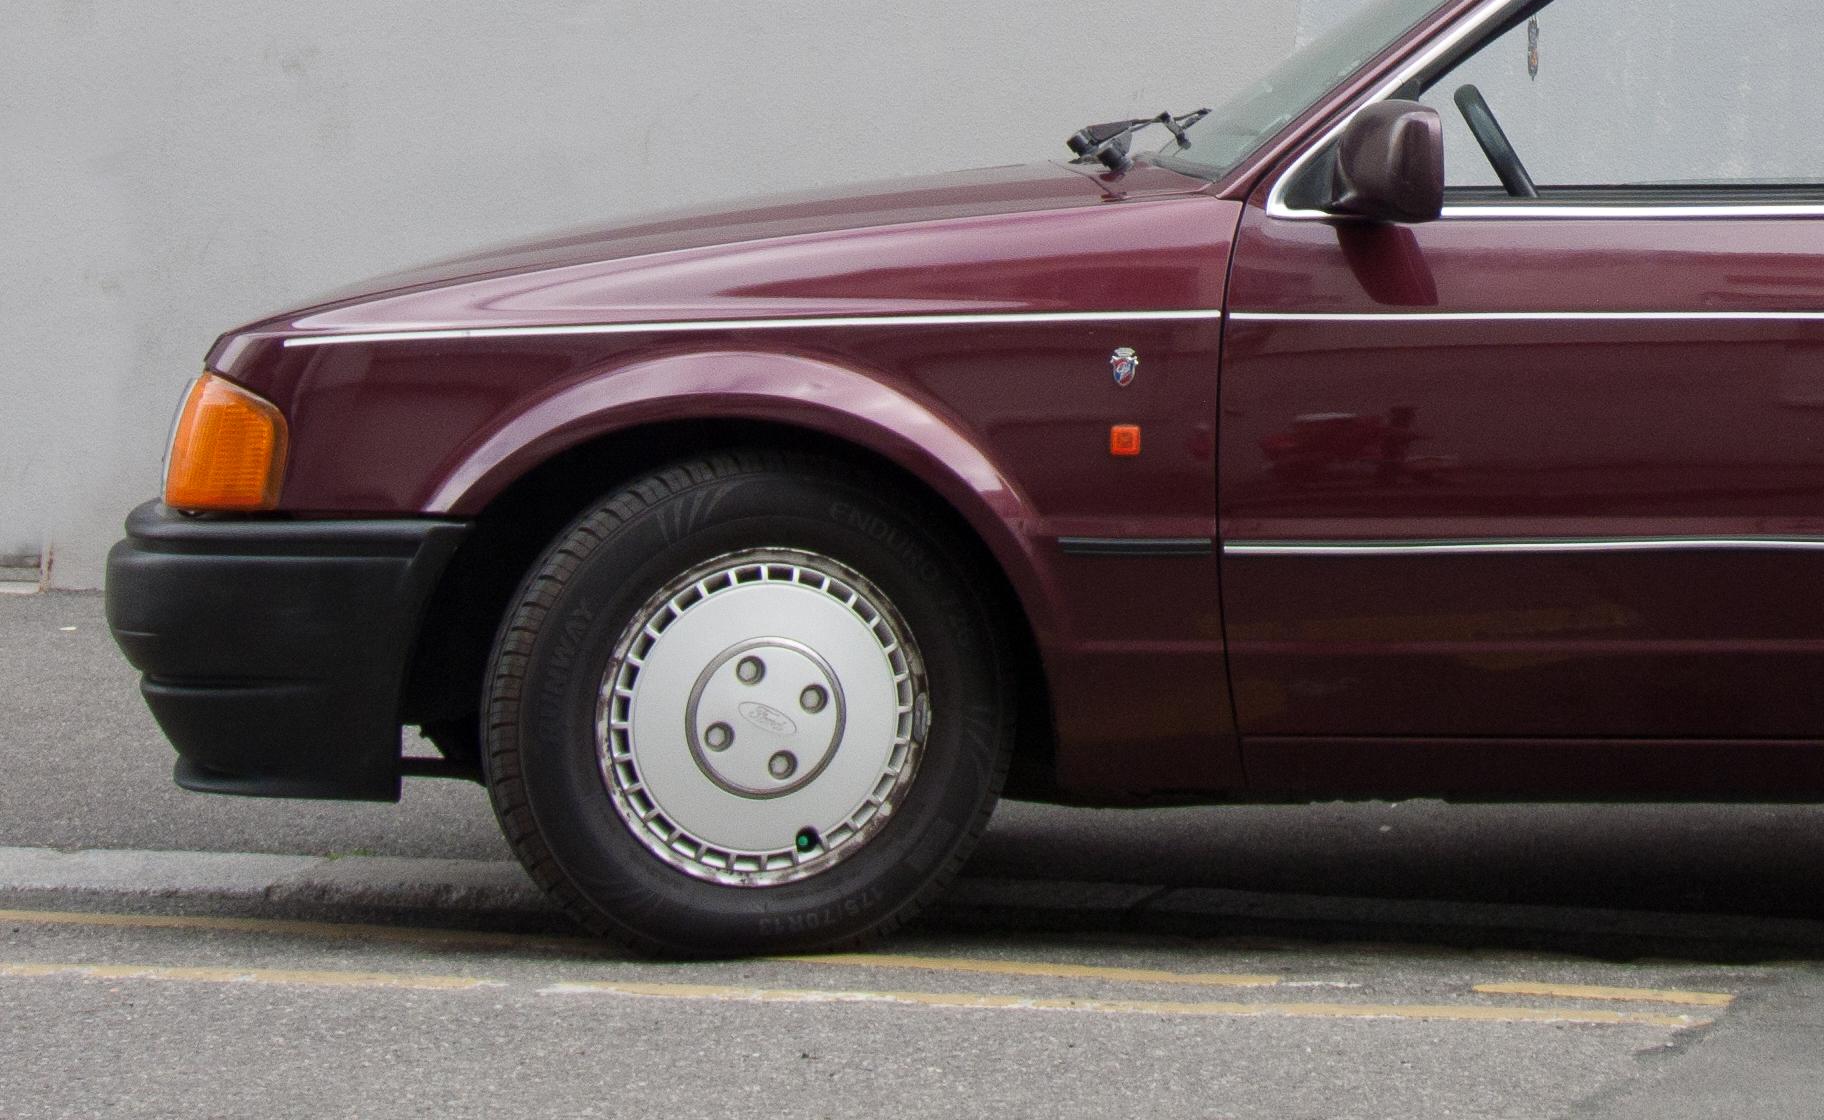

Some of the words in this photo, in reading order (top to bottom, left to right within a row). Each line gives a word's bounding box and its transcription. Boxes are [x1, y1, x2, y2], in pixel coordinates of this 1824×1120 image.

[828, 500, 941, 584] ENDURO
[745, 704, 790, 733] Ford
[758, 884, 883, 932] 175/70R13
